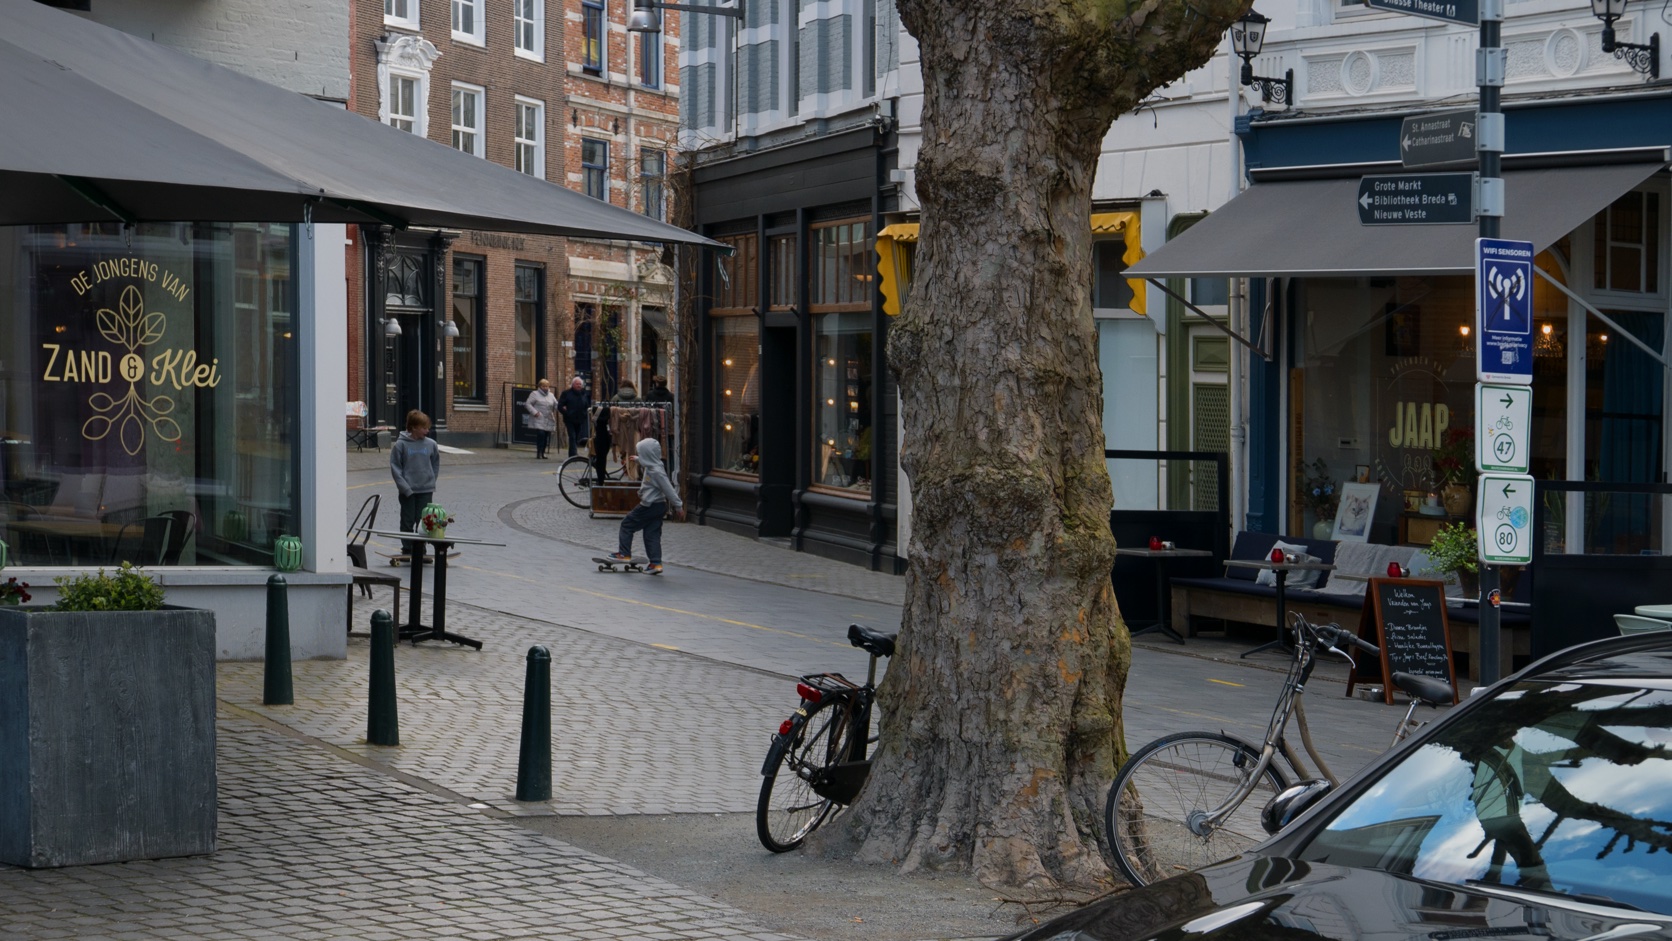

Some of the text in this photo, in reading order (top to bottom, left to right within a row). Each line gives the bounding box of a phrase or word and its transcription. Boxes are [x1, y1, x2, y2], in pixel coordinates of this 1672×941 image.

[1414, 0, 1444, 13] Theater
[1421, 119, 1451, 132] Annastraat
[1411, 132, 1454, 147] Catharinastraat
[1374, 180, 1422, 191] Grote Markt
[1374, 194, 1446, 205] Bibliotheek Breda
[1374, 208, 1427, 220] Nieuwe Veste
[1483, 247, 1531, 258] WIFI SENSOREN
[70, 258, 190, 303] DE JONGENS VAN
[42, 343, 112, 384] ZAND
[150, 348, 222, 391] Klei
[1388, 401, 1450, 450] JAAP
[1496, 441, 1512, 455] 47
[1498, 532, 1513, 546] 80
